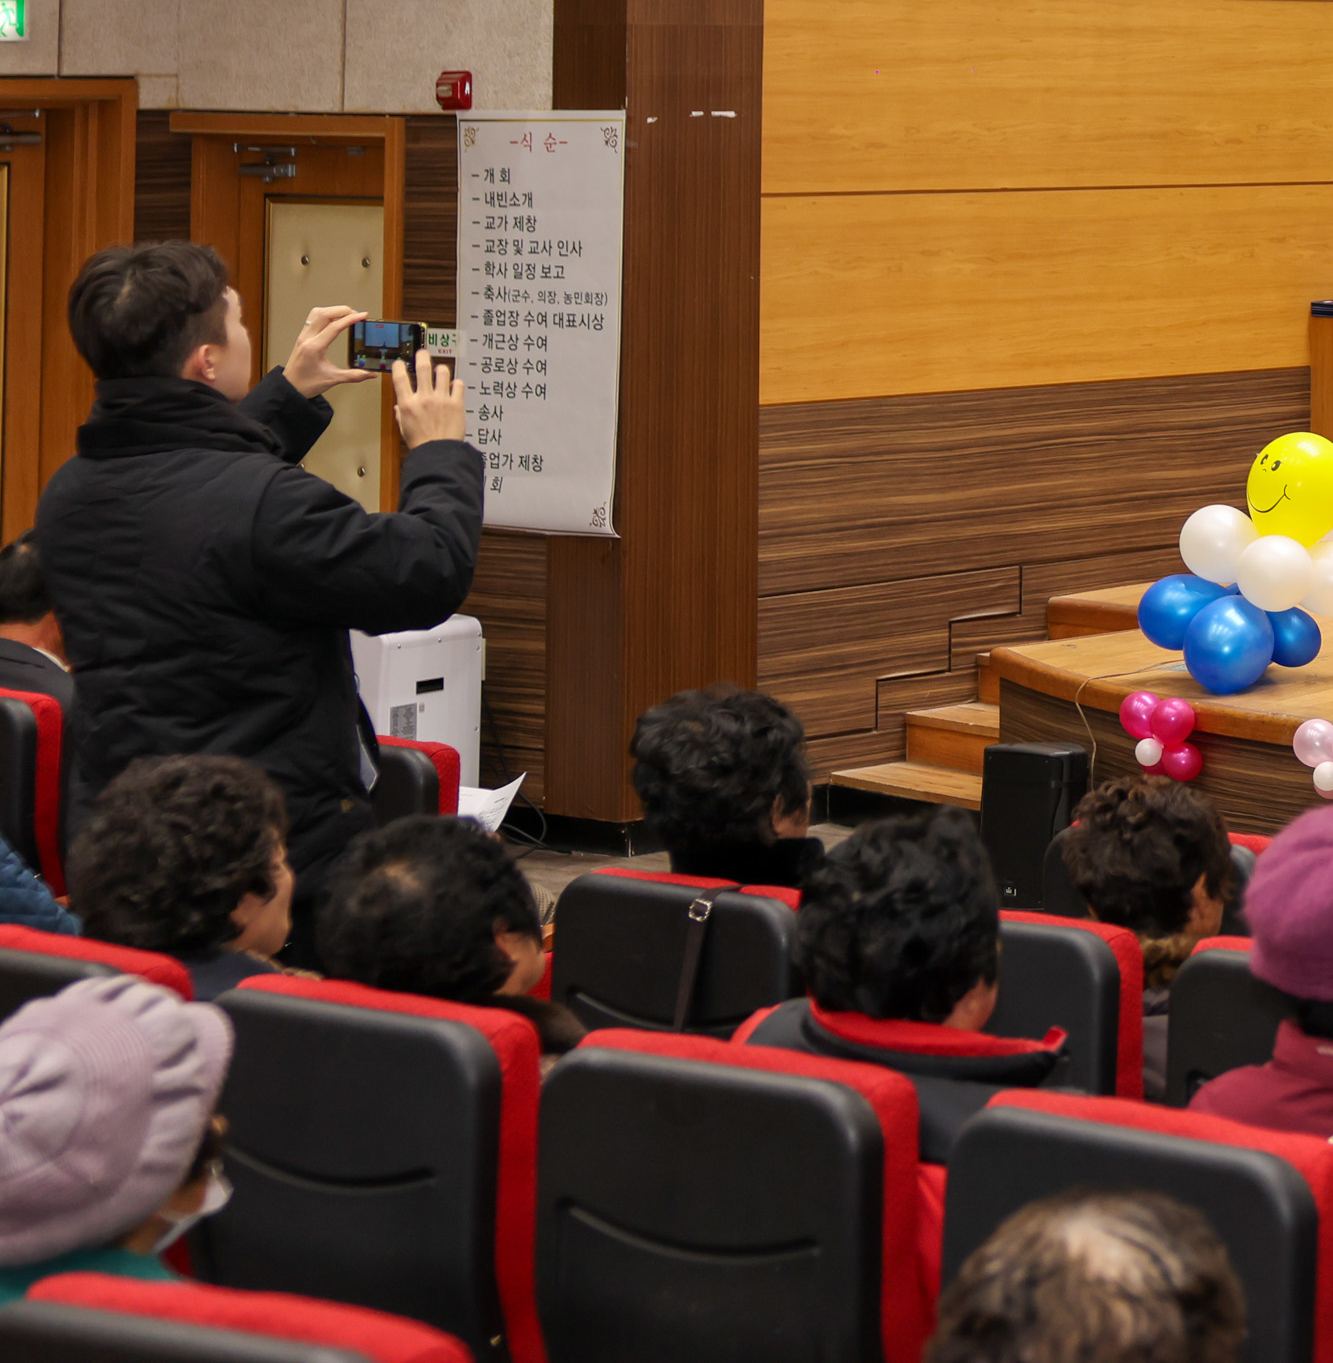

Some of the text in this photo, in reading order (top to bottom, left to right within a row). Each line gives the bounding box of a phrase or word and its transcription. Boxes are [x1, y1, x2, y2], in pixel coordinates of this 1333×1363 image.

[484, 191, 533, 208] 내빈소개
[484, 215, 537, 233] 교가 제창
[484, 238, 583, 257] 교장 및 교사 인사
[484, 261, 565, 280] 학사 일정 보고
[482, 308, 604, 331] 졸업장 수여 대표시상
[482, 333, 548, 352] 개근상 수여
[481, 356, 547, 376] 공로상 수여
[479, 380, 546, 400] 노력상 수여
[478, 403, 504, 422] 송사
[477, 428, 502, 445] 답사
[518, 454, 544, 472] 제창
[490, 476, 503, 493] 회
